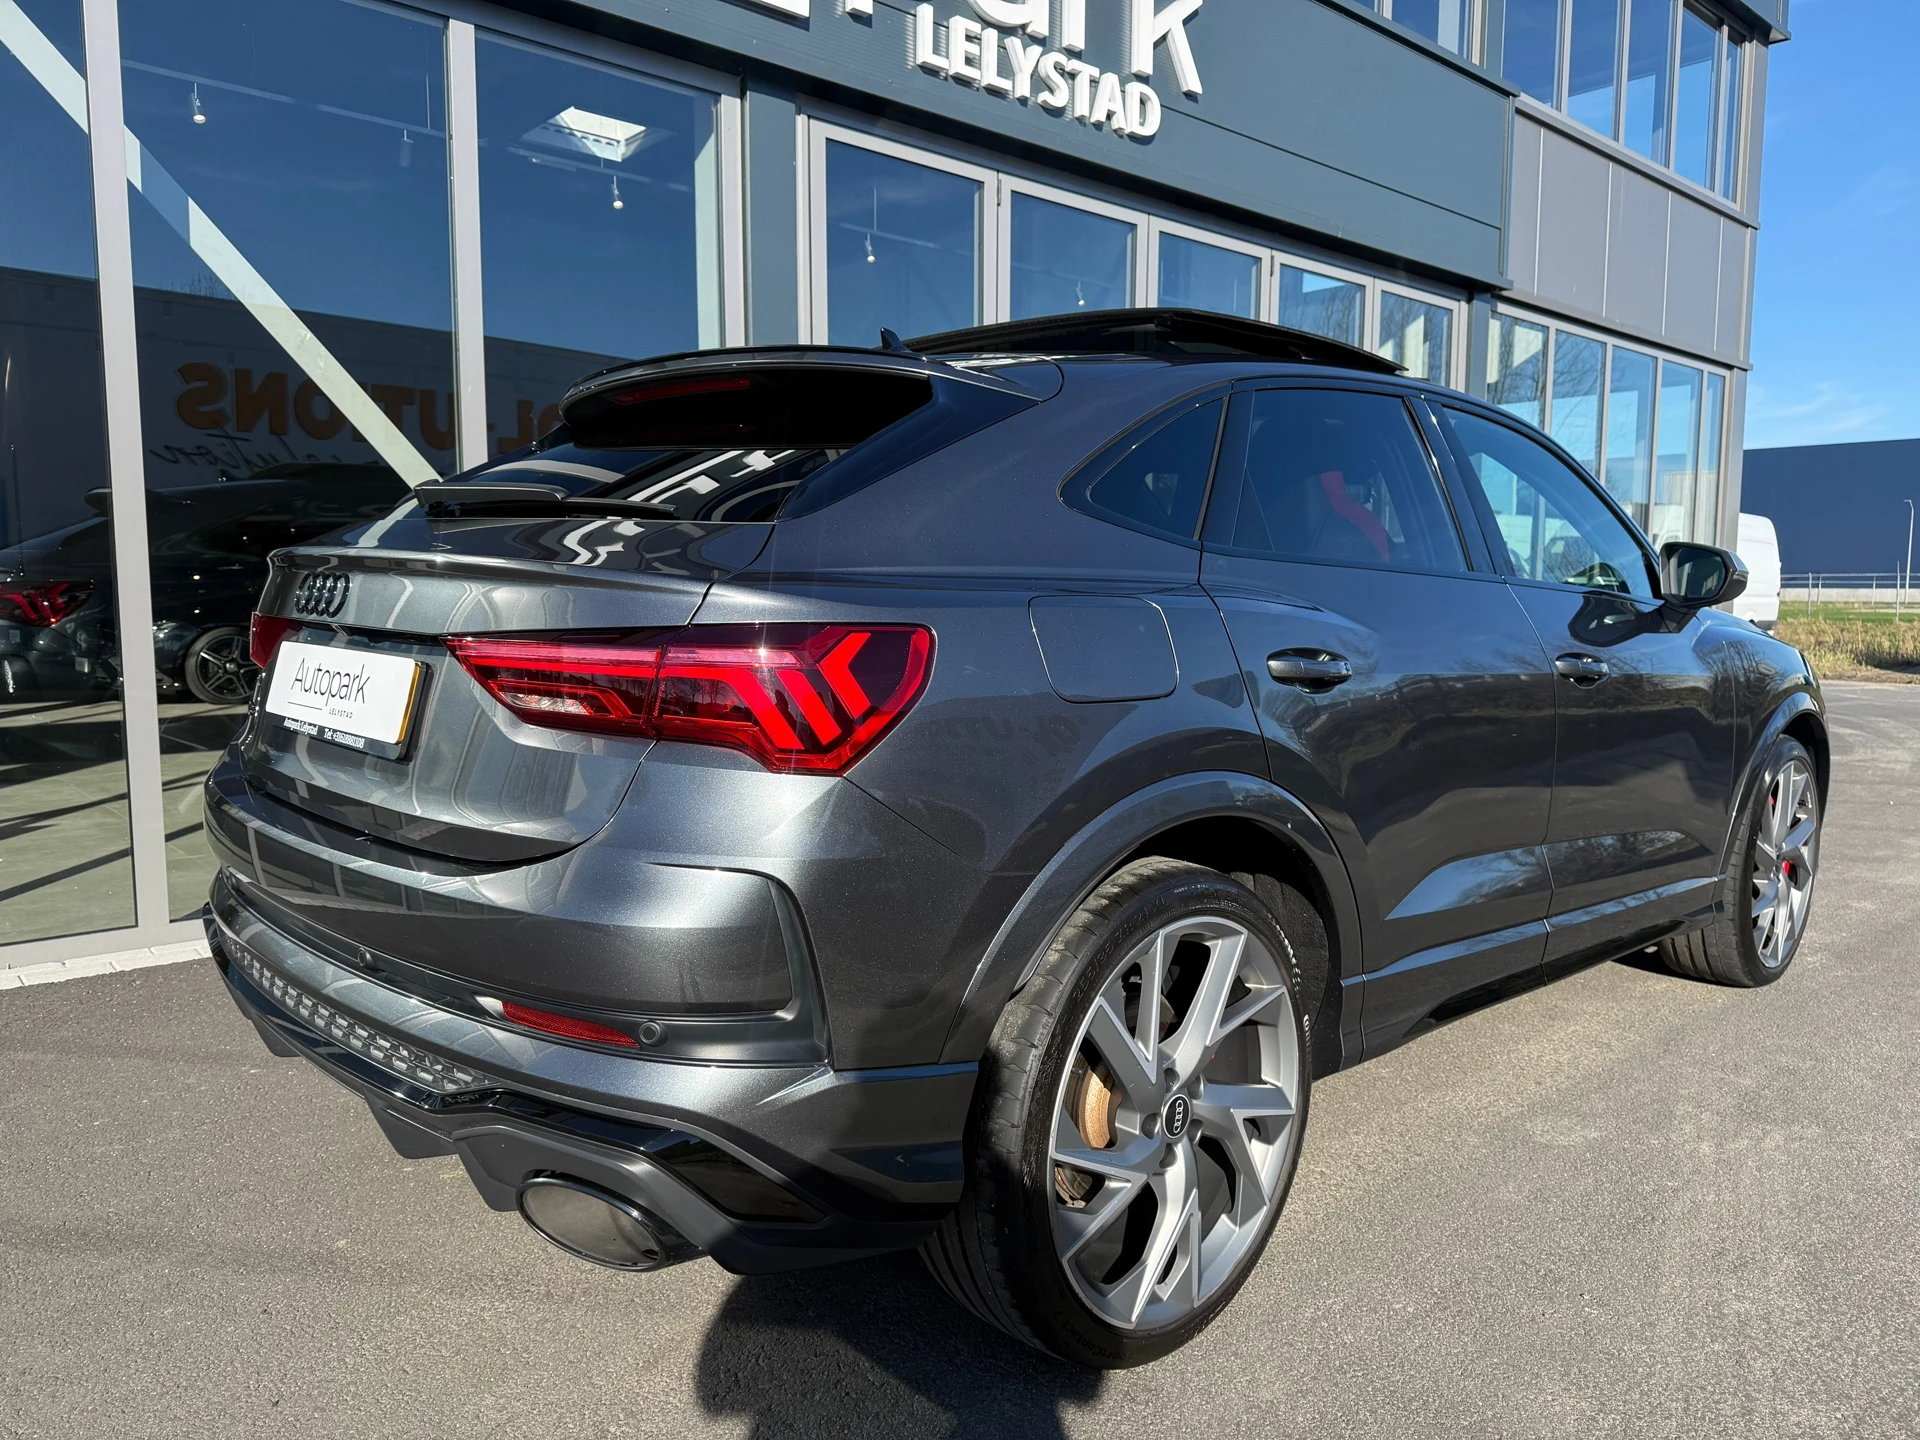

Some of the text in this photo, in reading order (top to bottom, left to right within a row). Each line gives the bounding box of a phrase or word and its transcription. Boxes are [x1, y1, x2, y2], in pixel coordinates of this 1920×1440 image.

[916, 3, 1162, 138] LELYSTAD
[291, 658, 370, 706] Autopark
[329, 708, 353, 719] LELYSTAD
